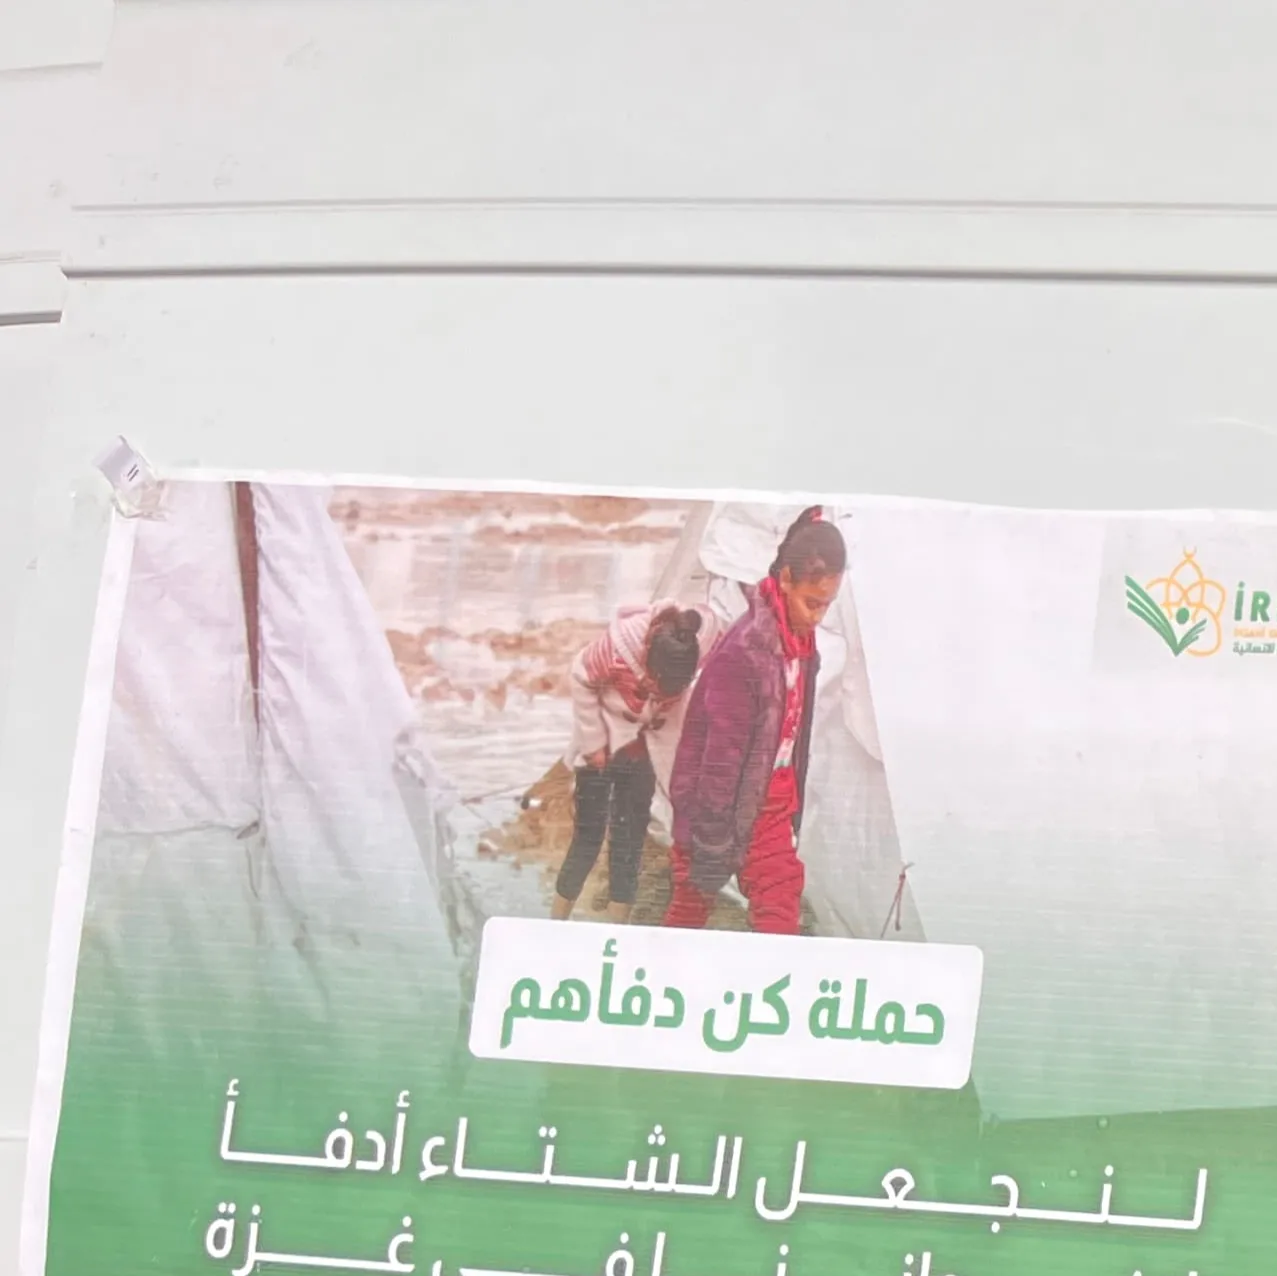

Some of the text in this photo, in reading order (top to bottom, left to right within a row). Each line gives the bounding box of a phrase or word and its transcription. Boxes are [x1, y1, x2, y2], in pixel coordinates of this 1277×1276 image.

[500, 938, 945, 1053] حملة كن دفأهم
